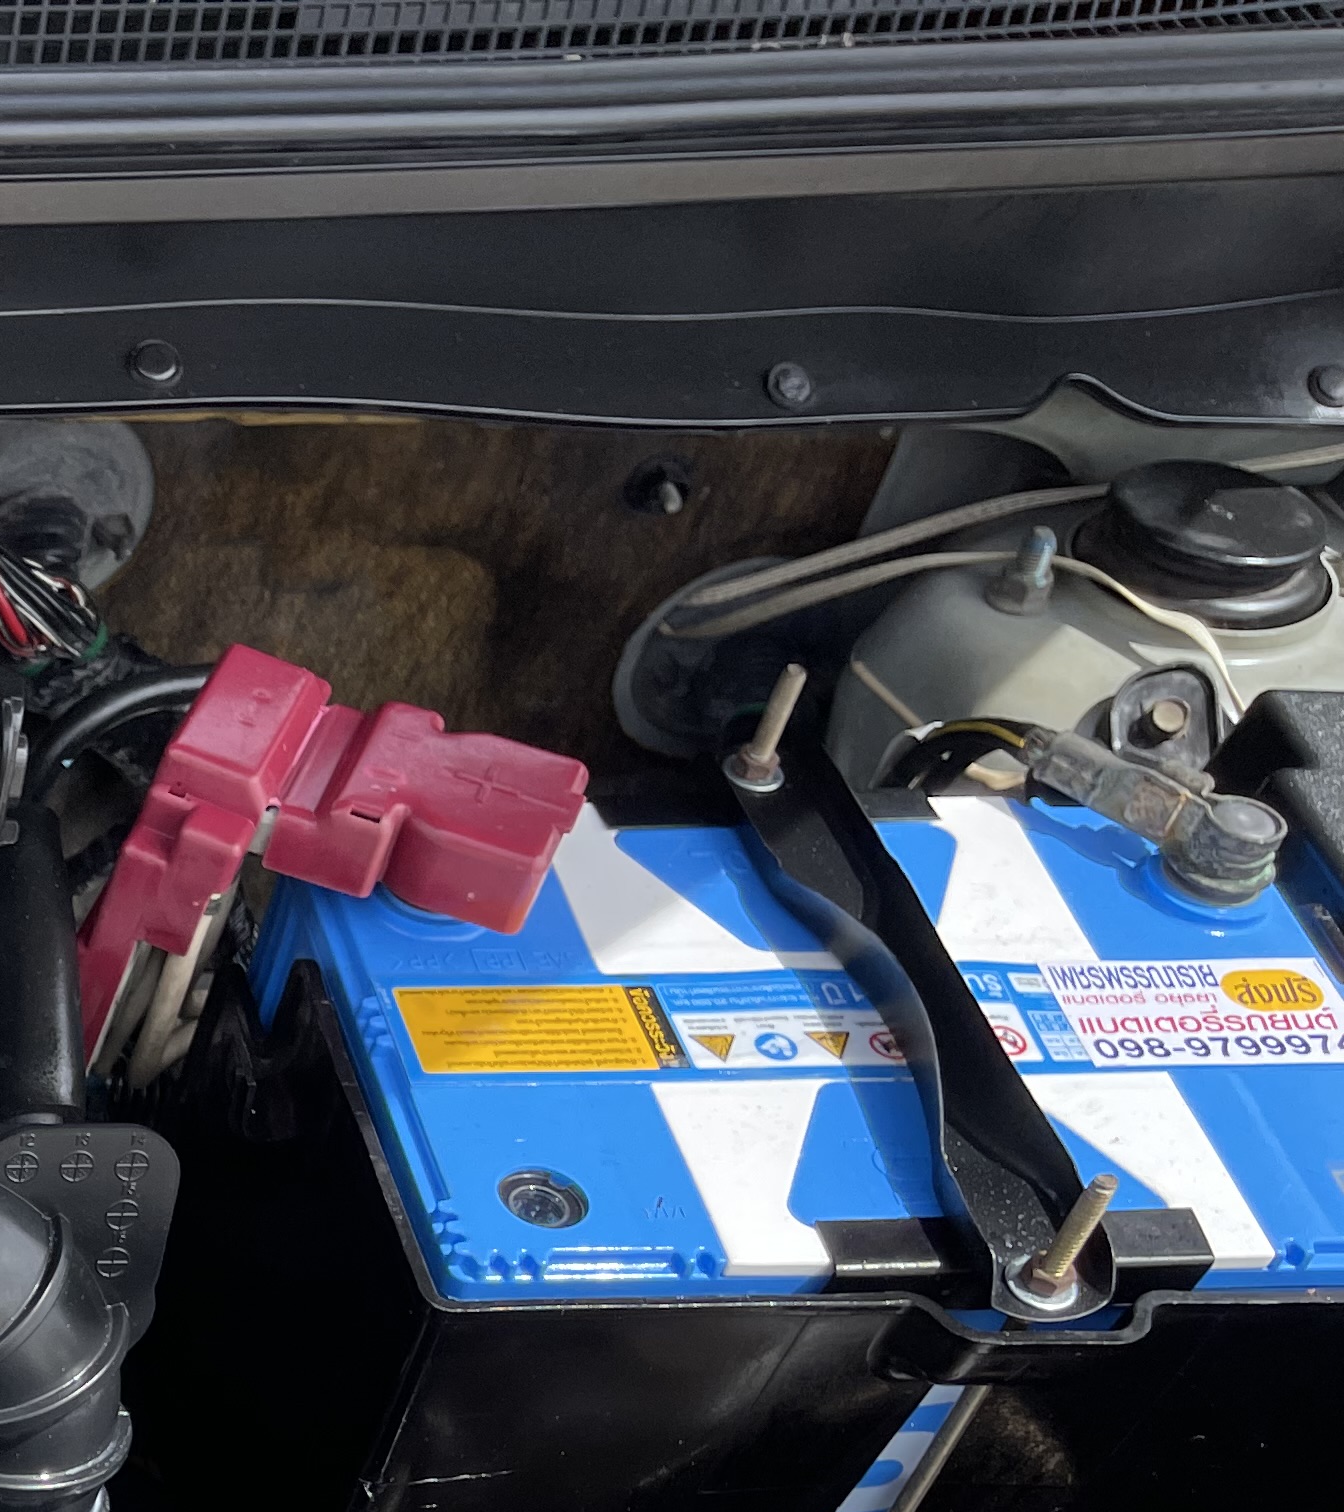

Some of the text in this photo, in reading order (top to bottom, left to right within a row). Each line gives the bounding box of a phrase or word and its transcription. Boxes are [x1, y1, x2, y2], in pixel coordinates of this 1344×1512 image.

[1154, 992, 1218, 1007] อยุธยา
[1234, 975, 1318, 1005] ส่งฟรี
